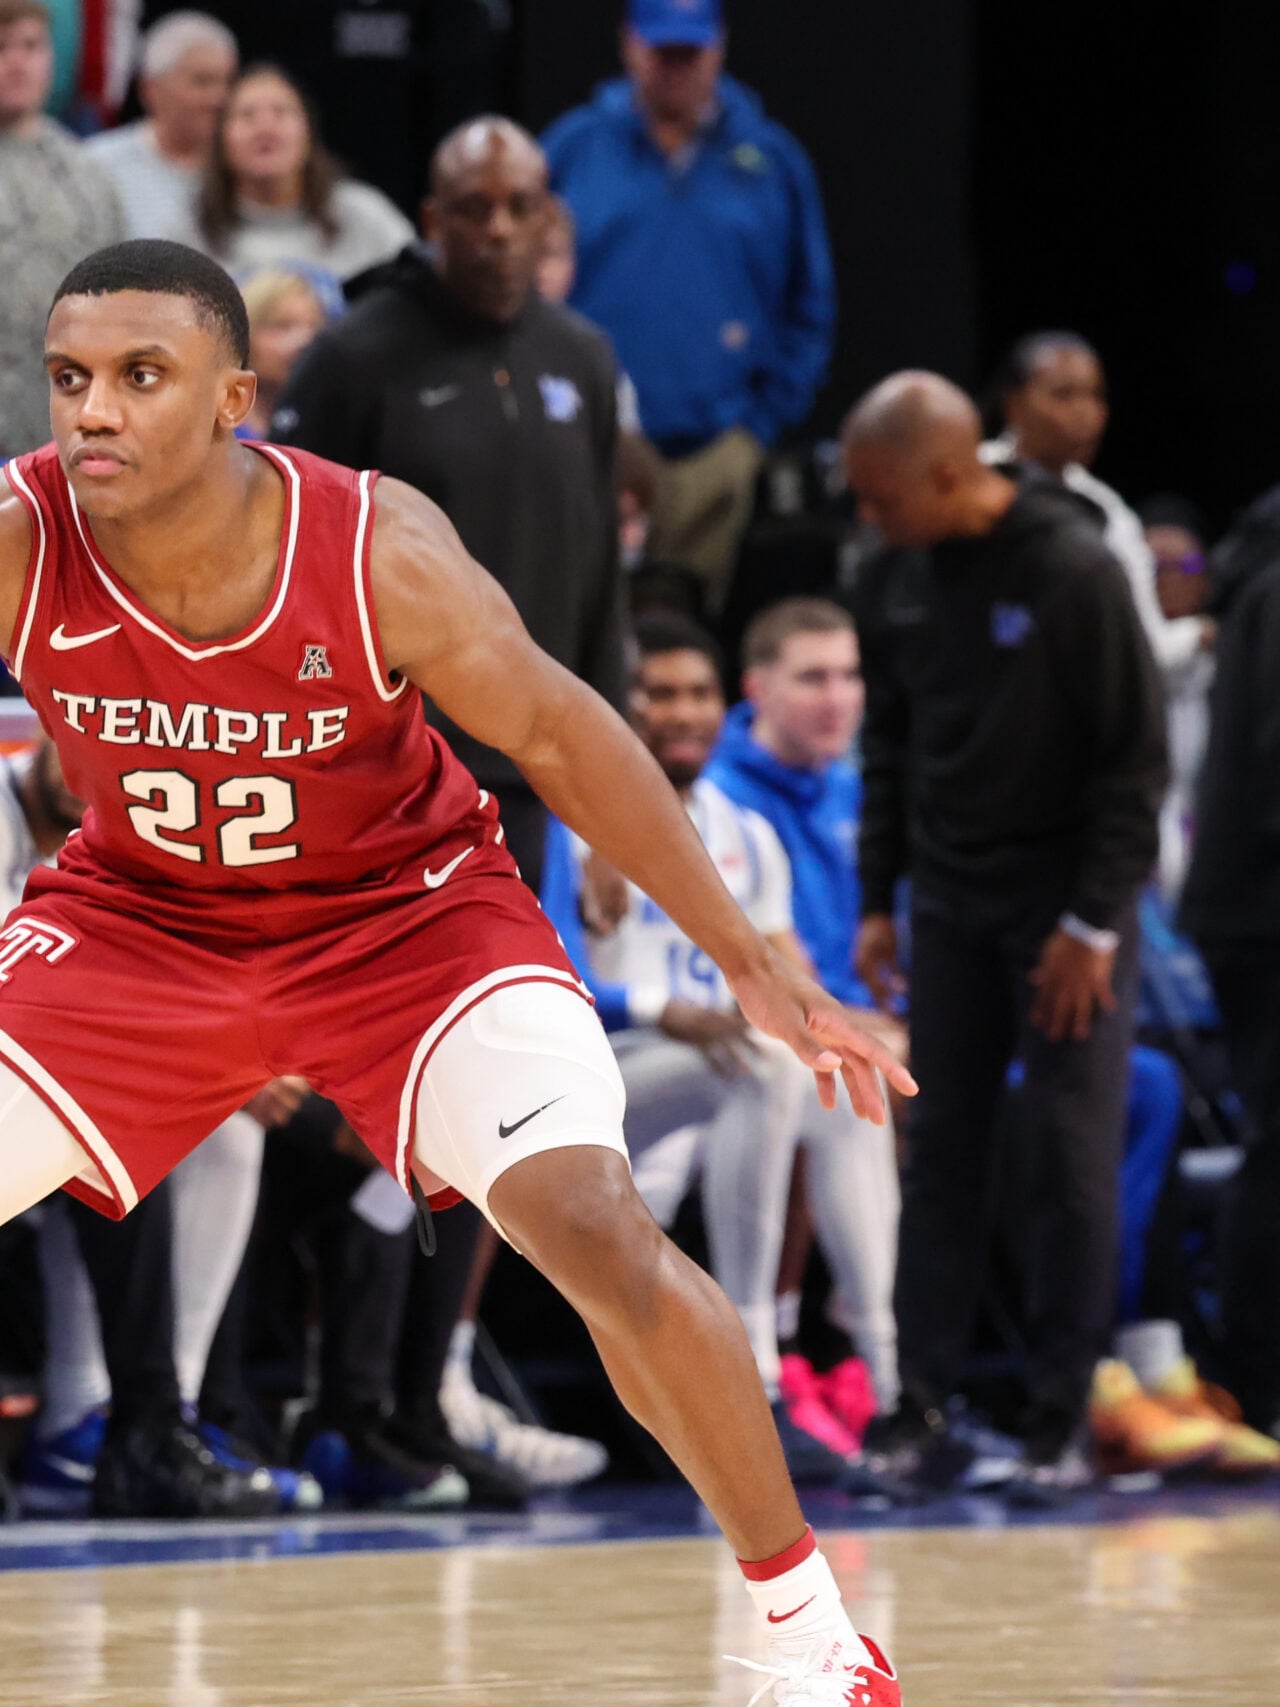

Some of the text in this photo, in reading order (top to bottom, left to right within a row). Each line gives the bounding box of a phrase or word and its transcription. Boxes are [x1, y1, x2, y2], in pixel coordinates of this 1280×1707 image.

[297, 644, 333, 681] A
[51, 688, 350, 759] TEMPLE
[119, 767, 302, 868] 22
